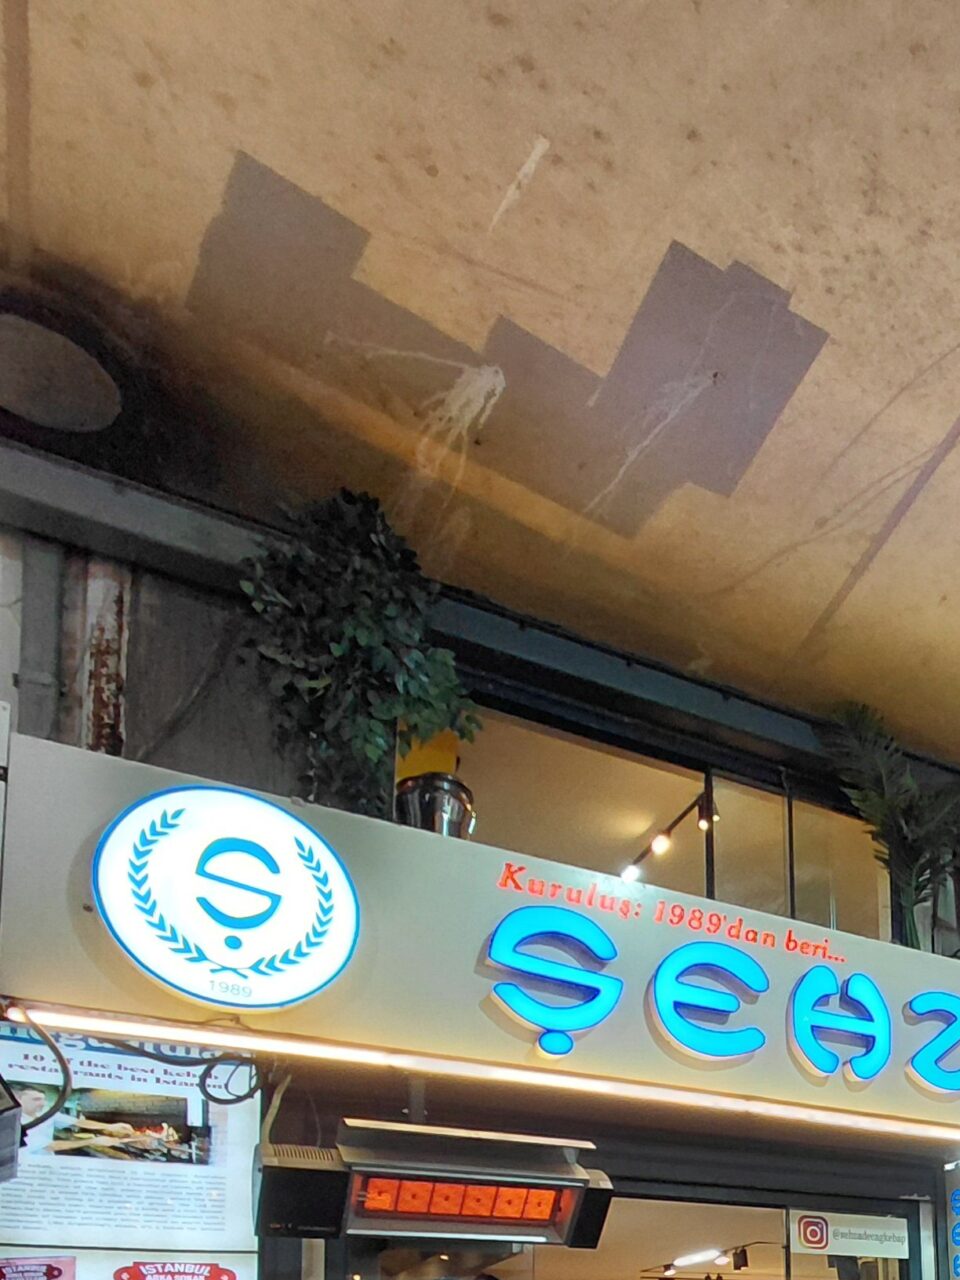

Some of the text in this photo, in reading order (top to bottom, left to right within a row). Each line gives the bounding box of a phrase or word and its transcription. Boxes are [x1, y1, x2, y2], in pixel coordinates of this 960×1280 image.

[498, 862, 846, 963] Kuruluş: 1989'dan beri...
[209, 980, 252, 998] 1989
[8, 1063, 123, 1080] restarants
[23, 1053, 45, 1062] 10
[163, 1068, 219, 1080] kebb
